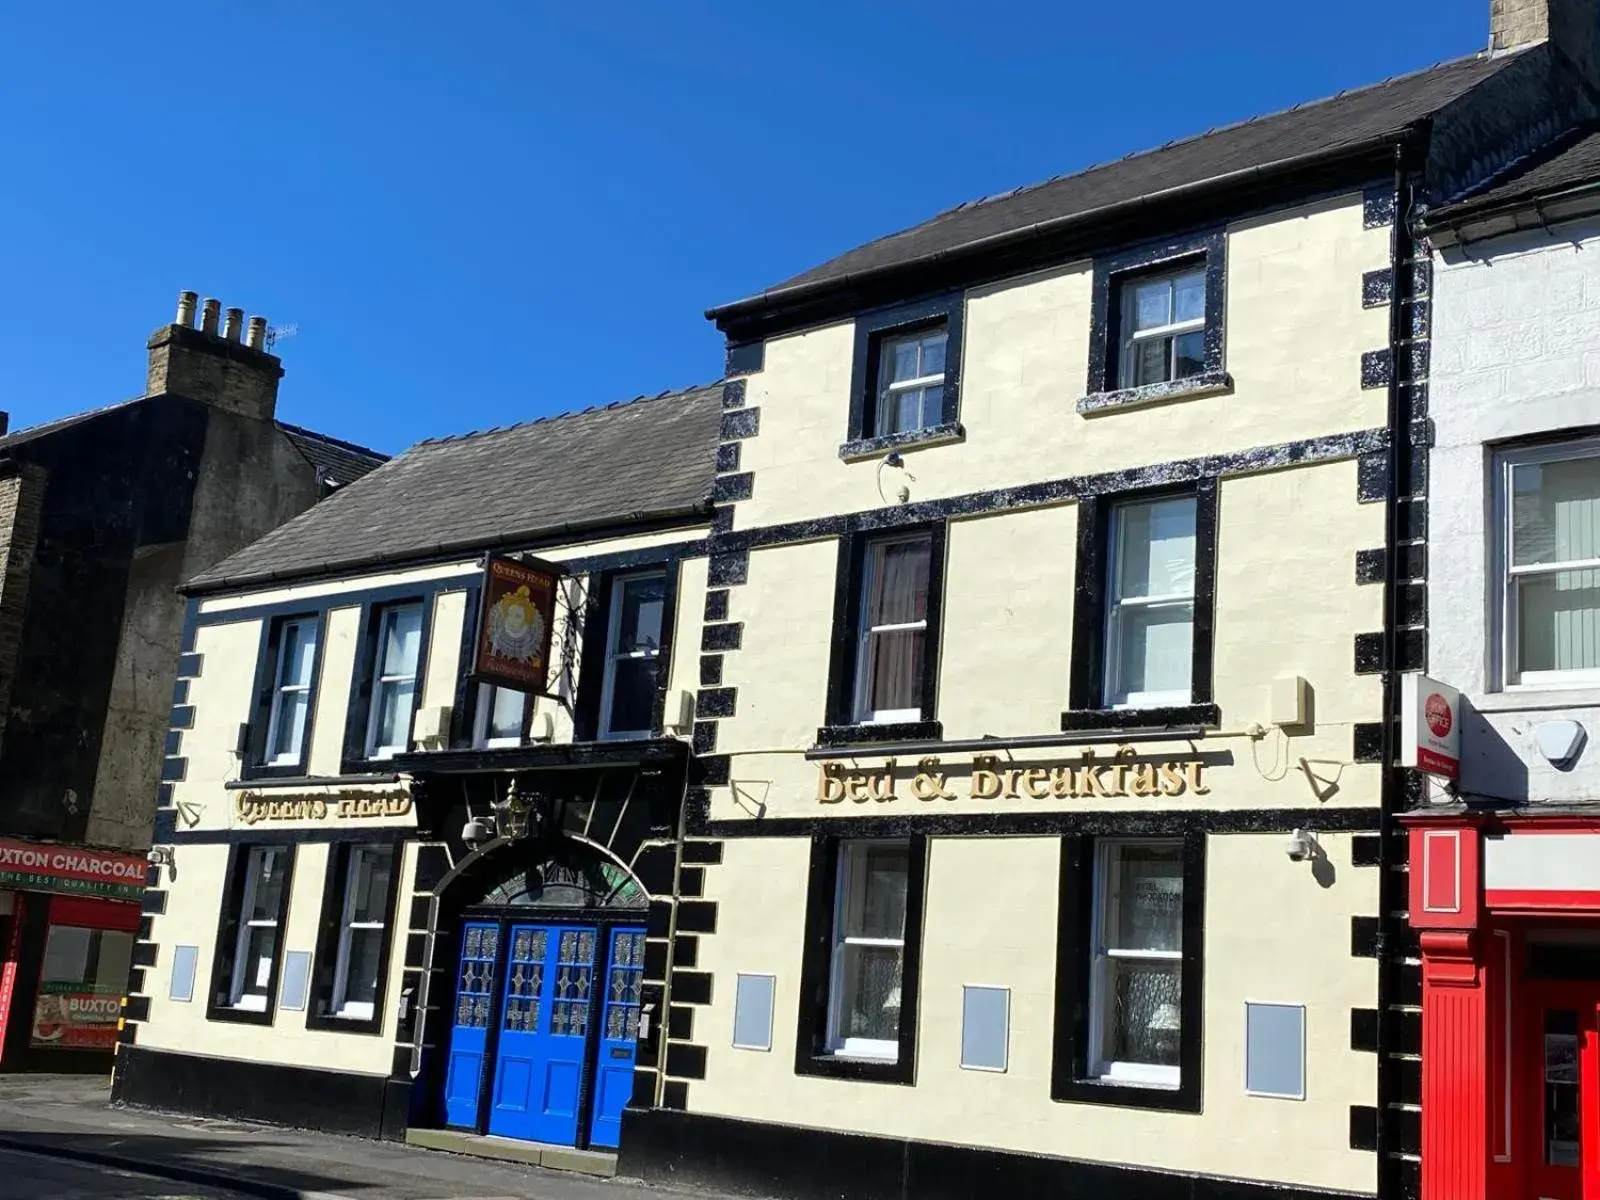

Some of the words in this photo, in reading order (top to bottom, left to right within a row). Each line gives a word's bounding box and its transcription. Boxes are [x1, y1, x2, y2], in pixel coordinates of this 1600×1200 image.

[492, 562, 526, 580] QUEENS
[817, 757, 897, 802] Bed
[909, 757, 957, 801] &
[967, 744, 1210, 799] Breakfast
[236, 790, 327, 824] QUEENS
[336, 790, 412, 818] HEAD
[0, 848, 49, 868] XTON
[52, 854, 144, 879] CHARCOAL
[29, 874, 57, 886] BEST
[63, 878, 112, 891] QUALITY
[69, 998, 121, 1015] BUXTO
